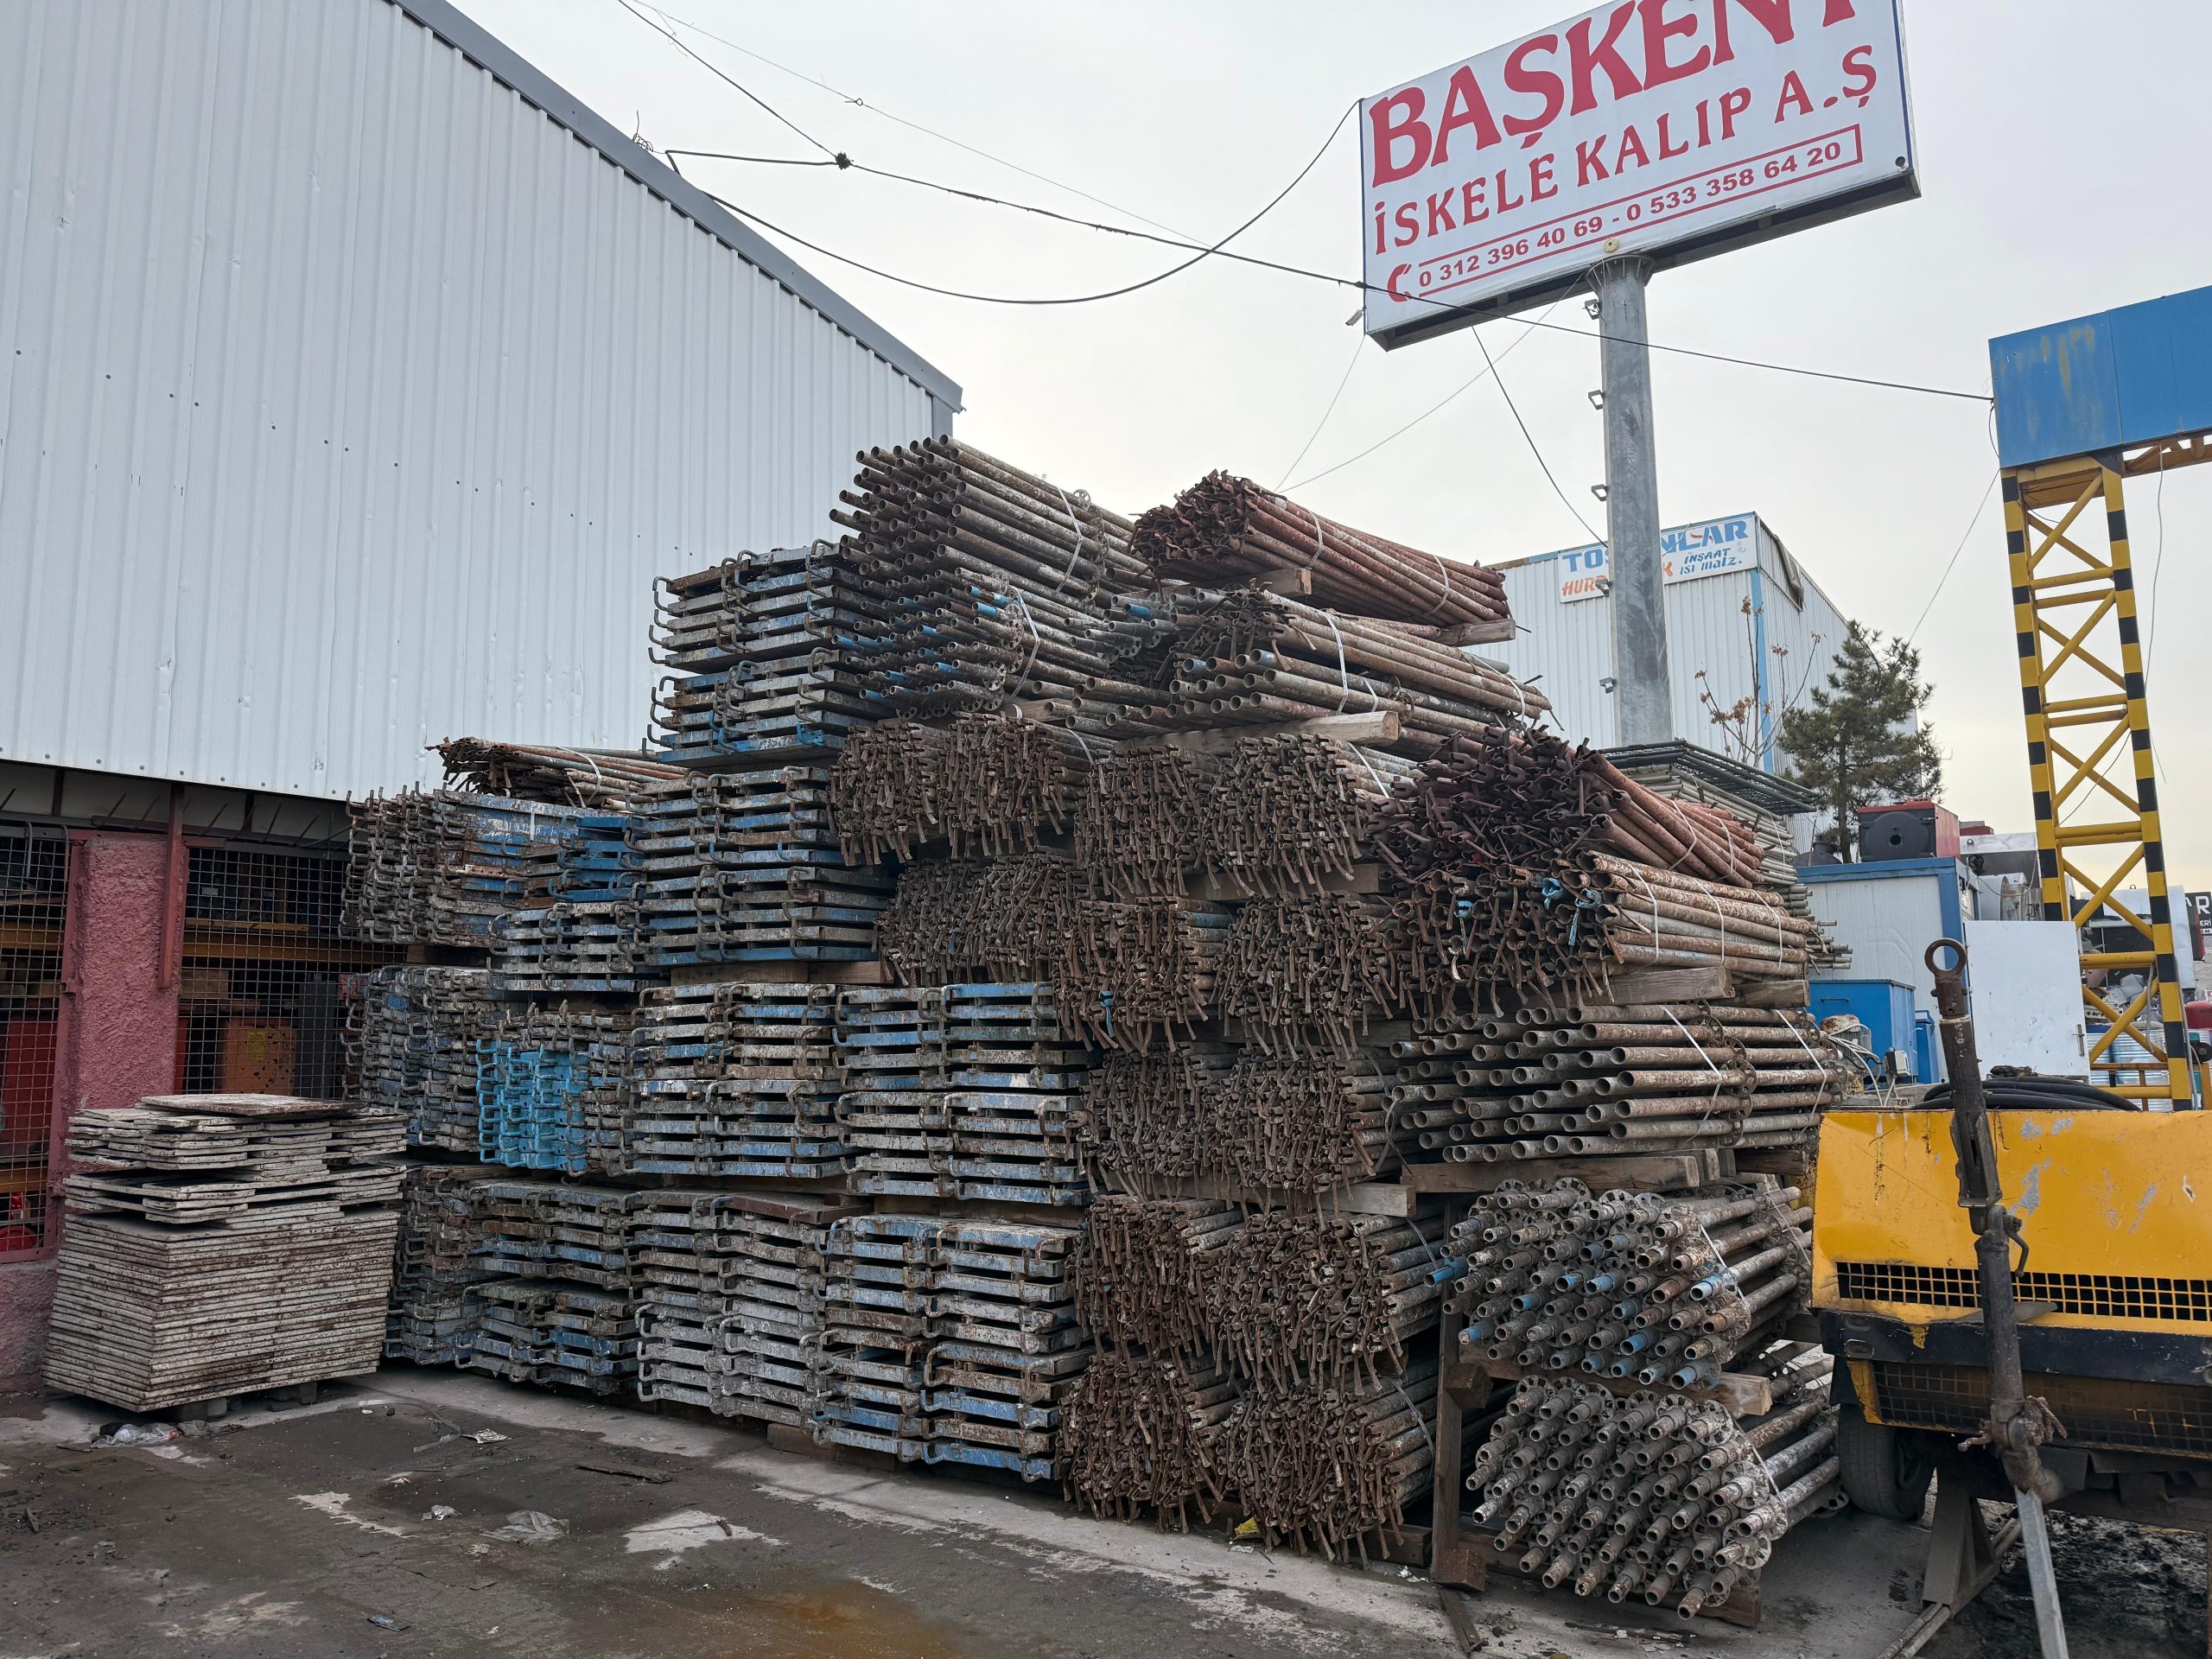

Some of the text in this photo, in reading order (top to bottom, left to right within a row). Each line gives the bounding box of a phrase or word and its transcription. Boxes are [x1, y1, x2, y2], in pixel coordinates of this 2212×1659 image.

[1369, 0, 1856, 188] BAŞKEN
[1374, 44, 1878, 256] İSKELE KALIP A.Ş
[1419, 270, 1433, 287] 0
[1440, 255, 1480, 281] 312
[1487, 238, 1529, 265] 396
[1536, 227, 1566, 248] 40
[1573, 216, 1603, 237] 69
[1626, 203, 1642, 221] 0
[1650, 187, 1697, 214] 533
[1706, 168, 1755, 197] 358
[1764, 154, 1798, 179] 64
[1807, 142, 1841, 167] 20
